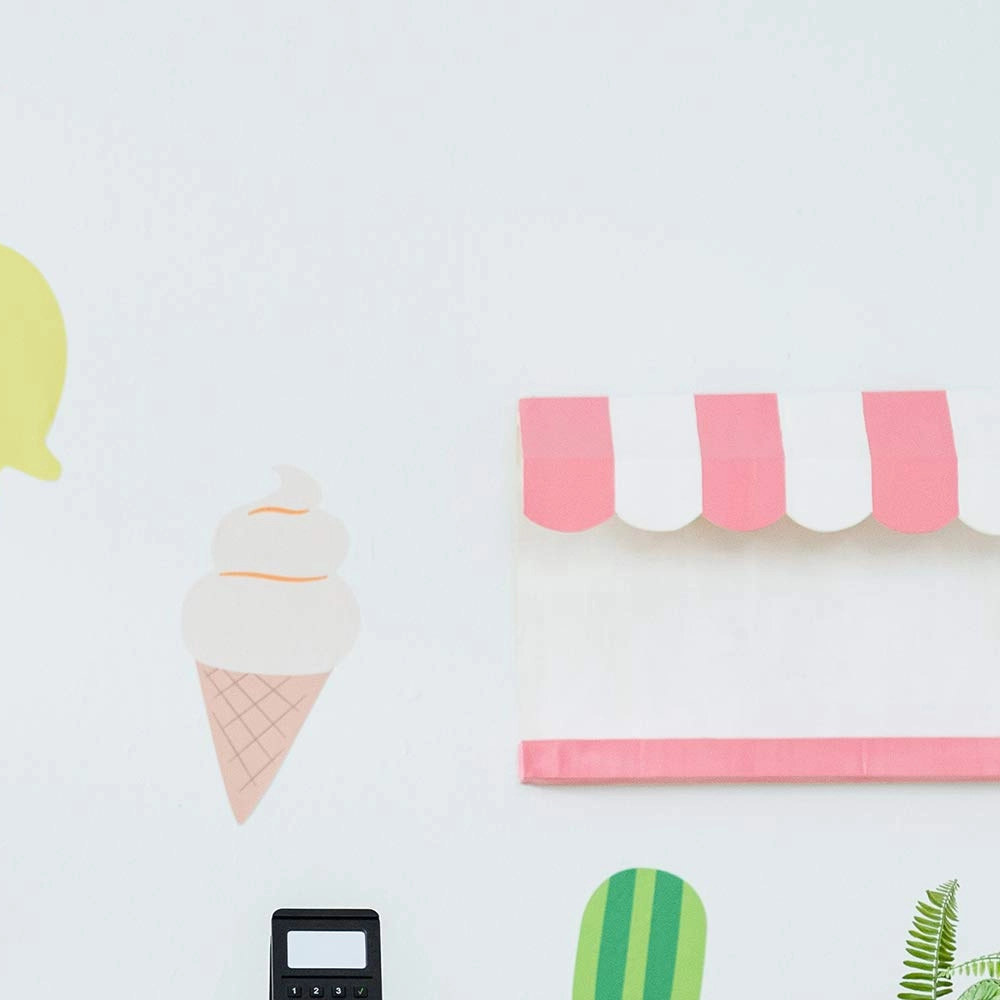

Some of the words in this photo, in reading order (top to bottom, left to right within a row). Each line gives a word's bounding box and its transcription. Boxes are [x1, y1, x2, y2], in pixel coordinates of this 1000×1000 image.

[291, 987, 297, 995] 1
[313, 987, 320, 995] 2
[335, 987, 342, 995] 3
